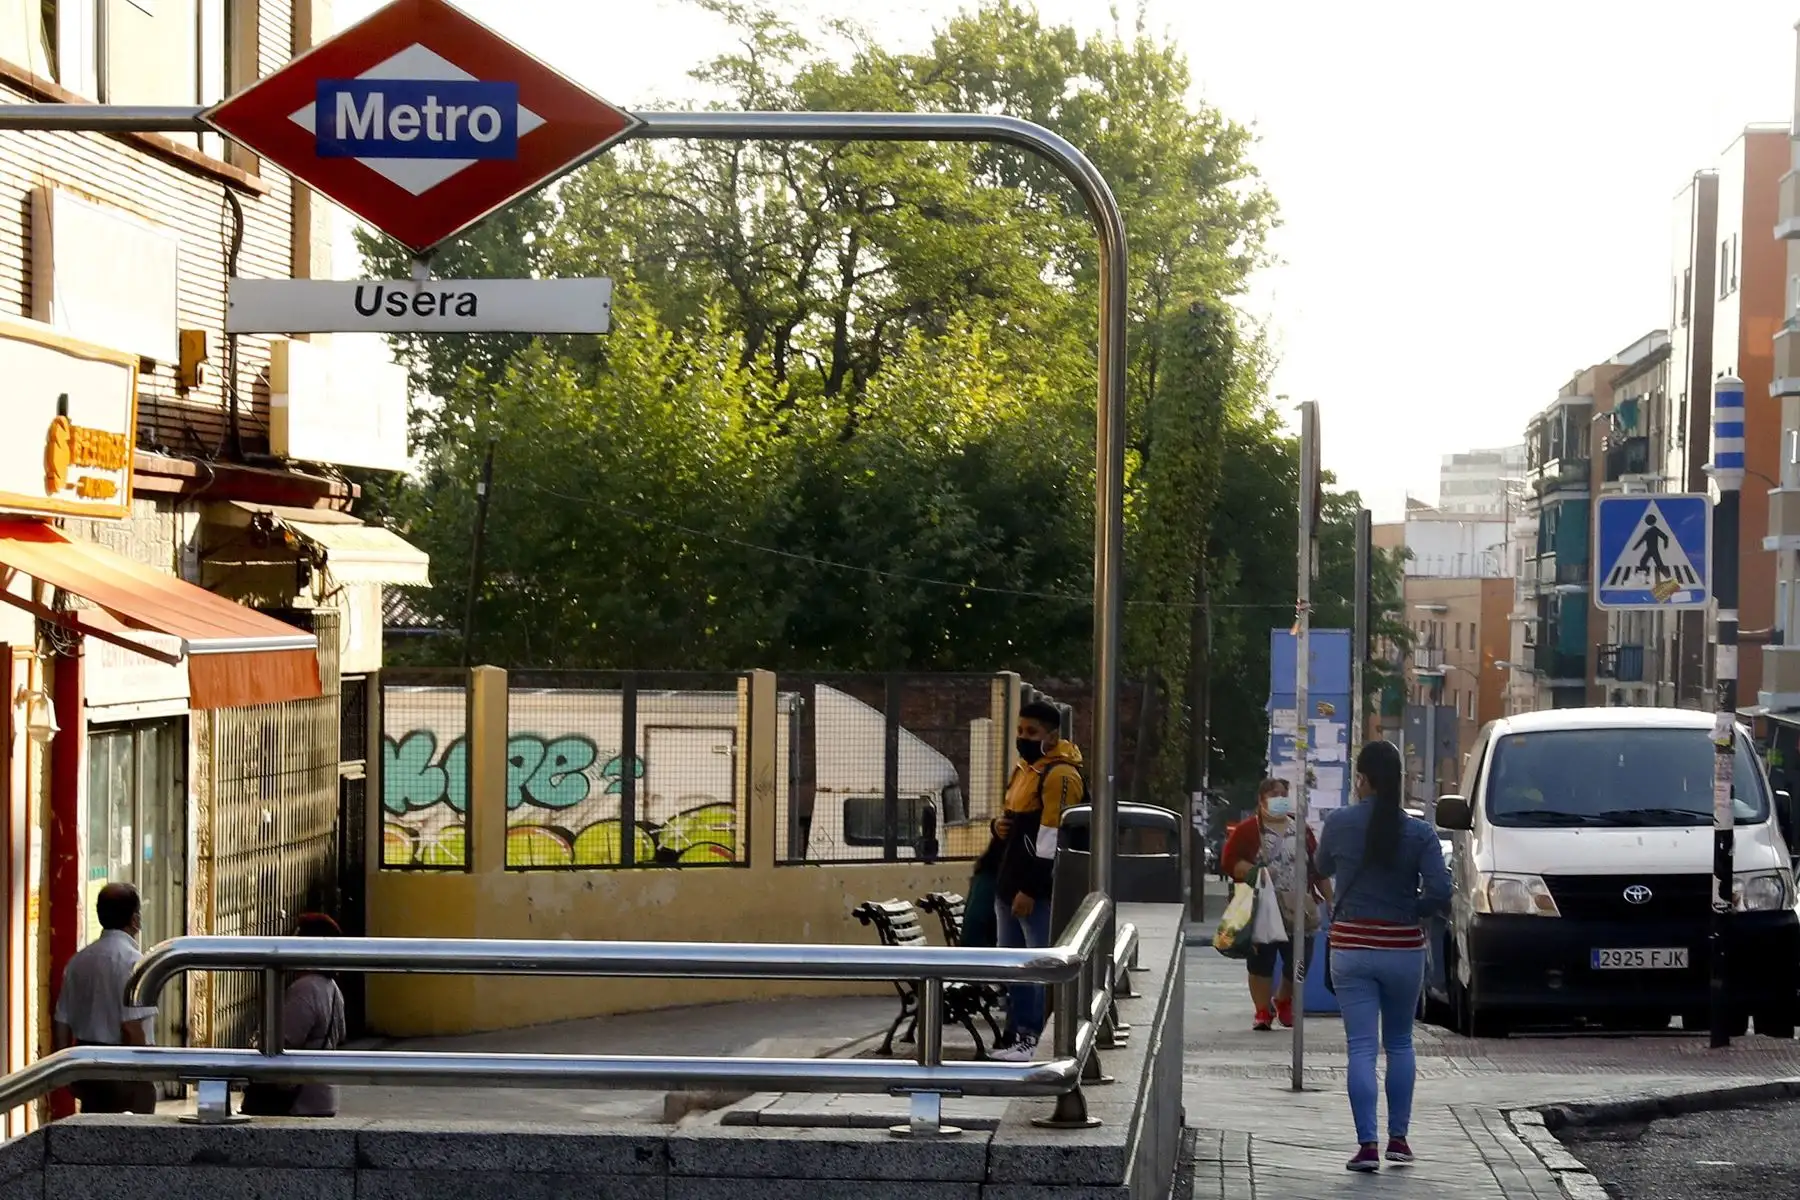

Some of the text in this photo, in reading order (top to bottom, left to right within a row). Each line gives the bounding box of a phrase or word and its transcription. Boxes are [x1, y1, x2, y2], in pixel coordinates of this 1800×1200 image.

[335, 91, 502, 143] Metro
[354, 285, 478, 317] Usera
[1601, 950, 1685, 967] 2925 FJK
